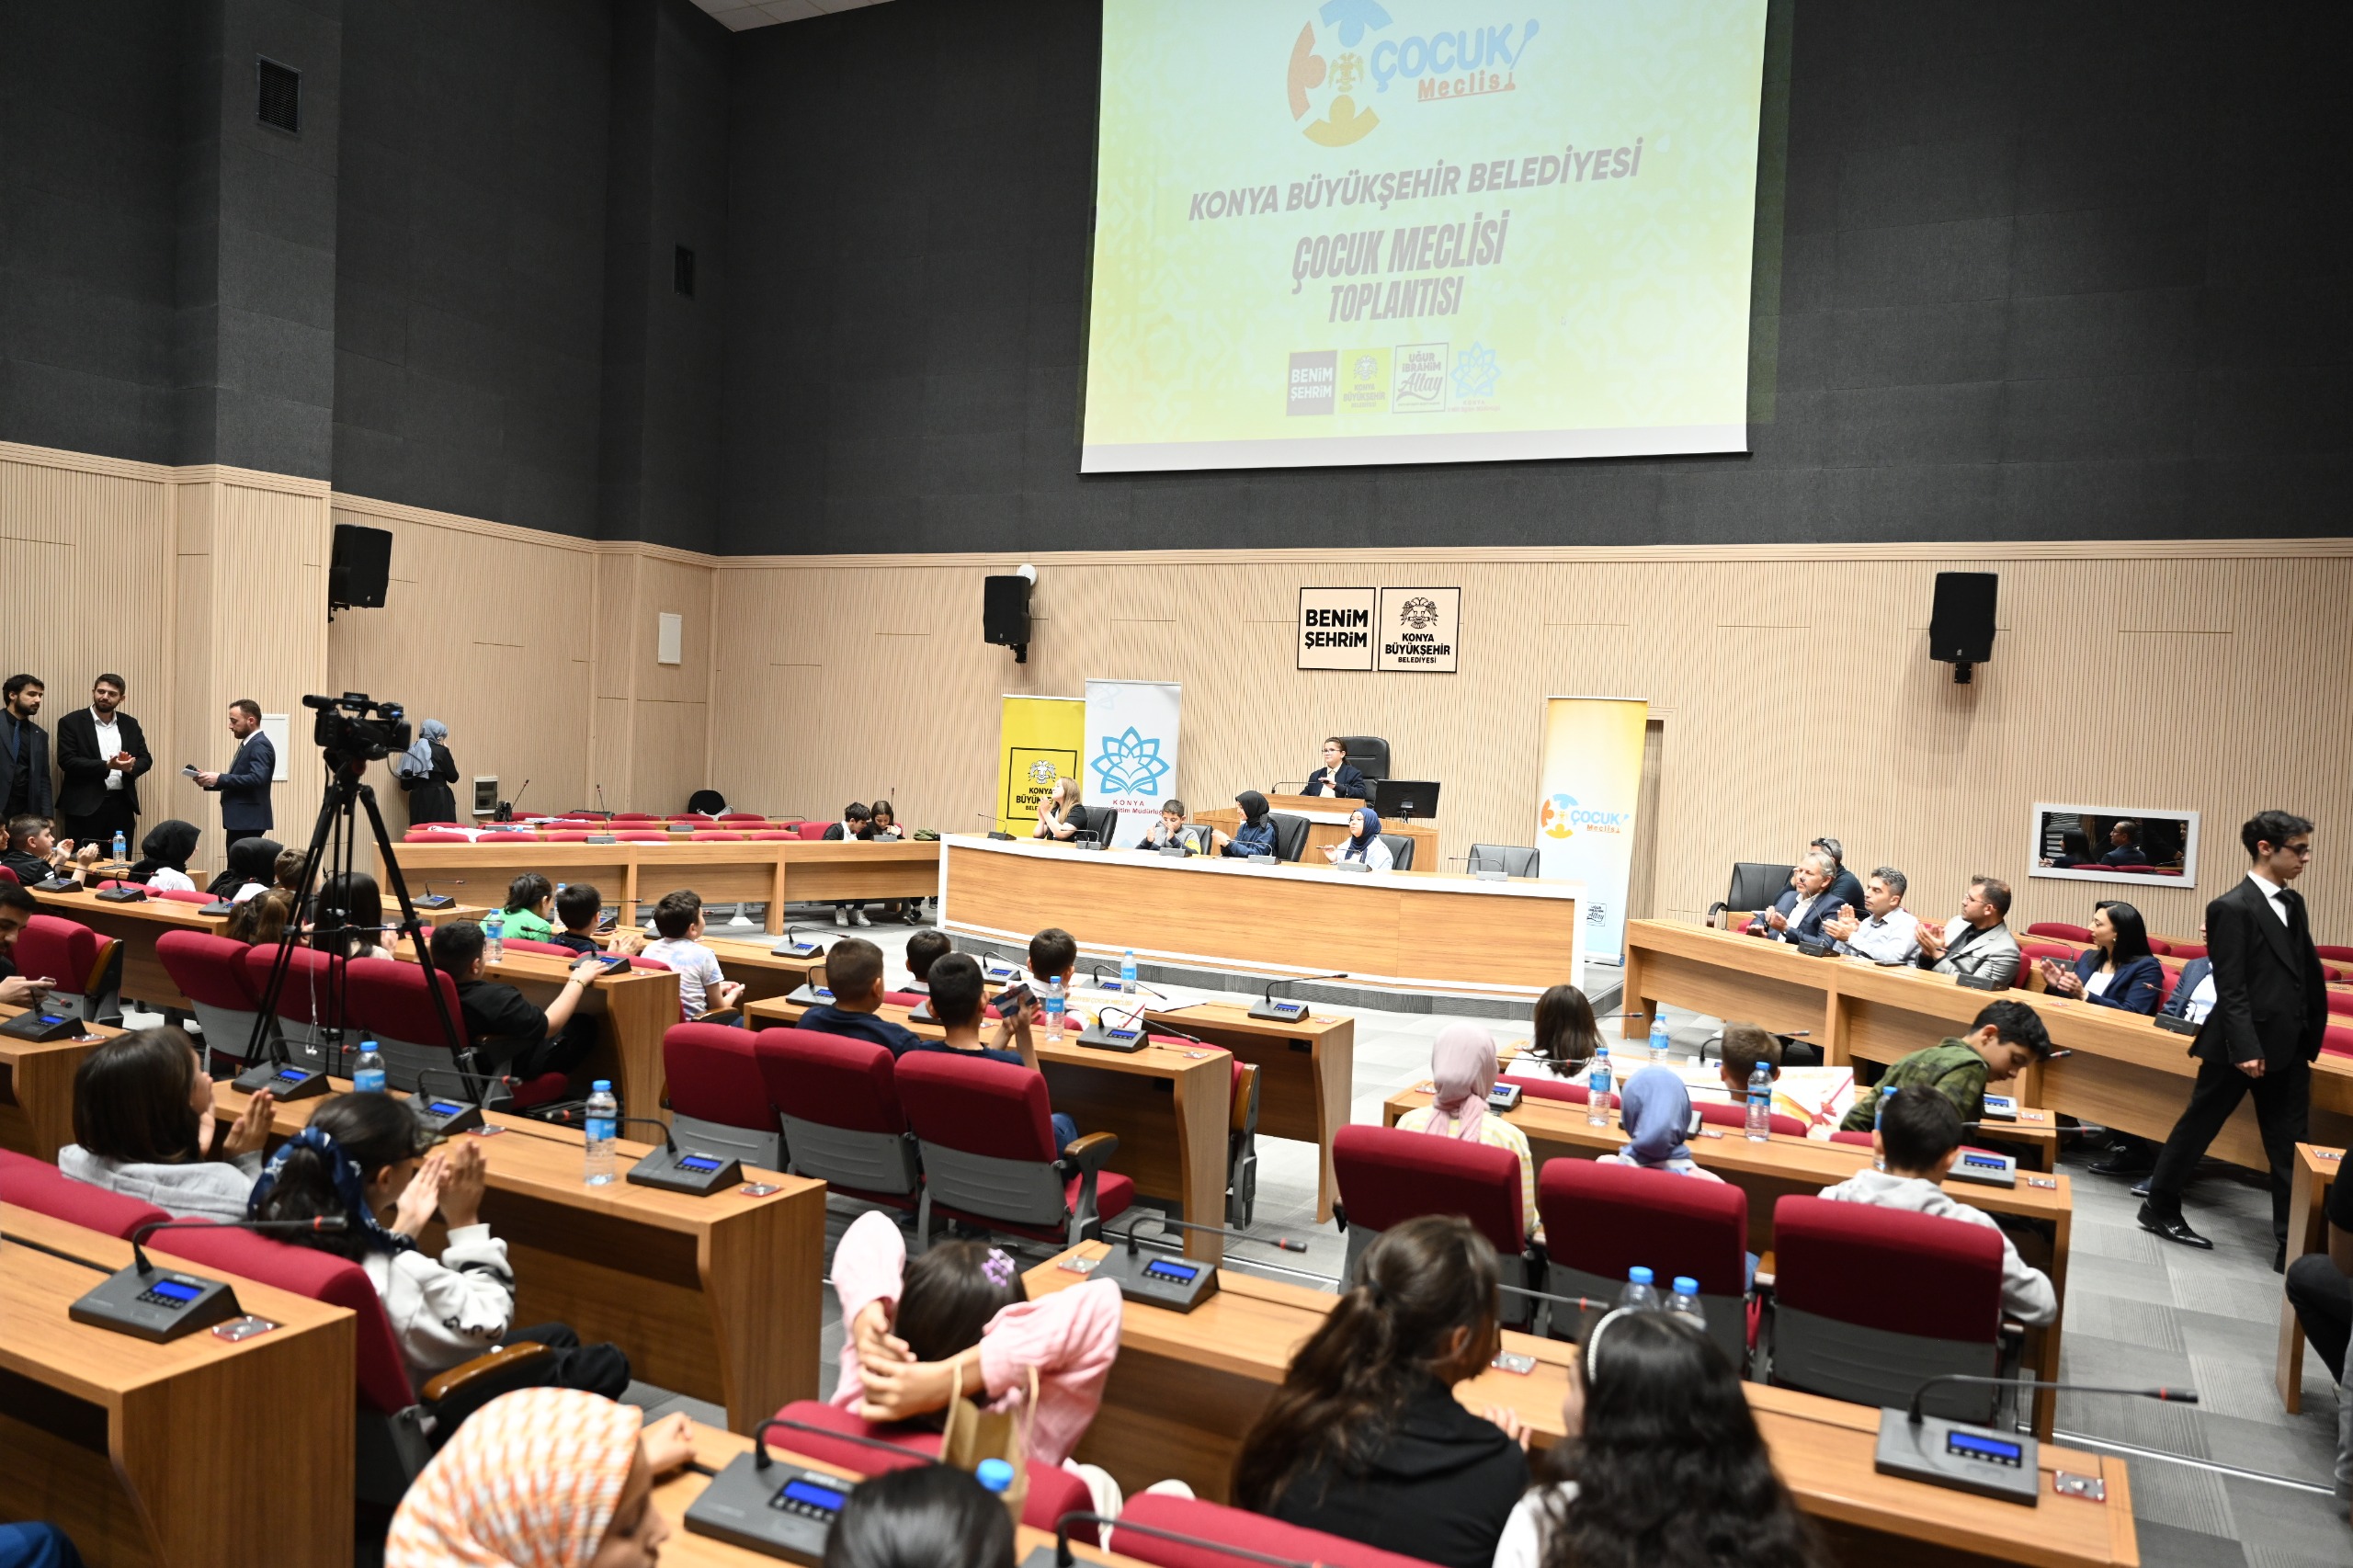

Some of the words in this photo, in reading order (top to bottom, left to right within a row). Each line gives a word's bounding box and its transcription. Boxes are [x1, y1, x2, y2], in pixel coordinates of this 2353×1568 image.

[1188, 185, 1278, 221] KONYA
[1286, 158, 1461, 210] BÜYÜKŞEHİR
[1467, 136, 1643, 193] BELEDİYESİ
[1291, 230, 1385, 294] ÇOCUK
[1387, 210, 1510, 272] MECLİSİ
[1328, 276, 1464, 323] TOPLANTISI
[1408, 350, 1435, 362] UĞUR
[1402, 633, 1434, 642] KONYA
[1385, 642, 1450, 656] BÜYÜKŞEHİR
[1398, 655, 1437, 664] BELEDİYESİ
